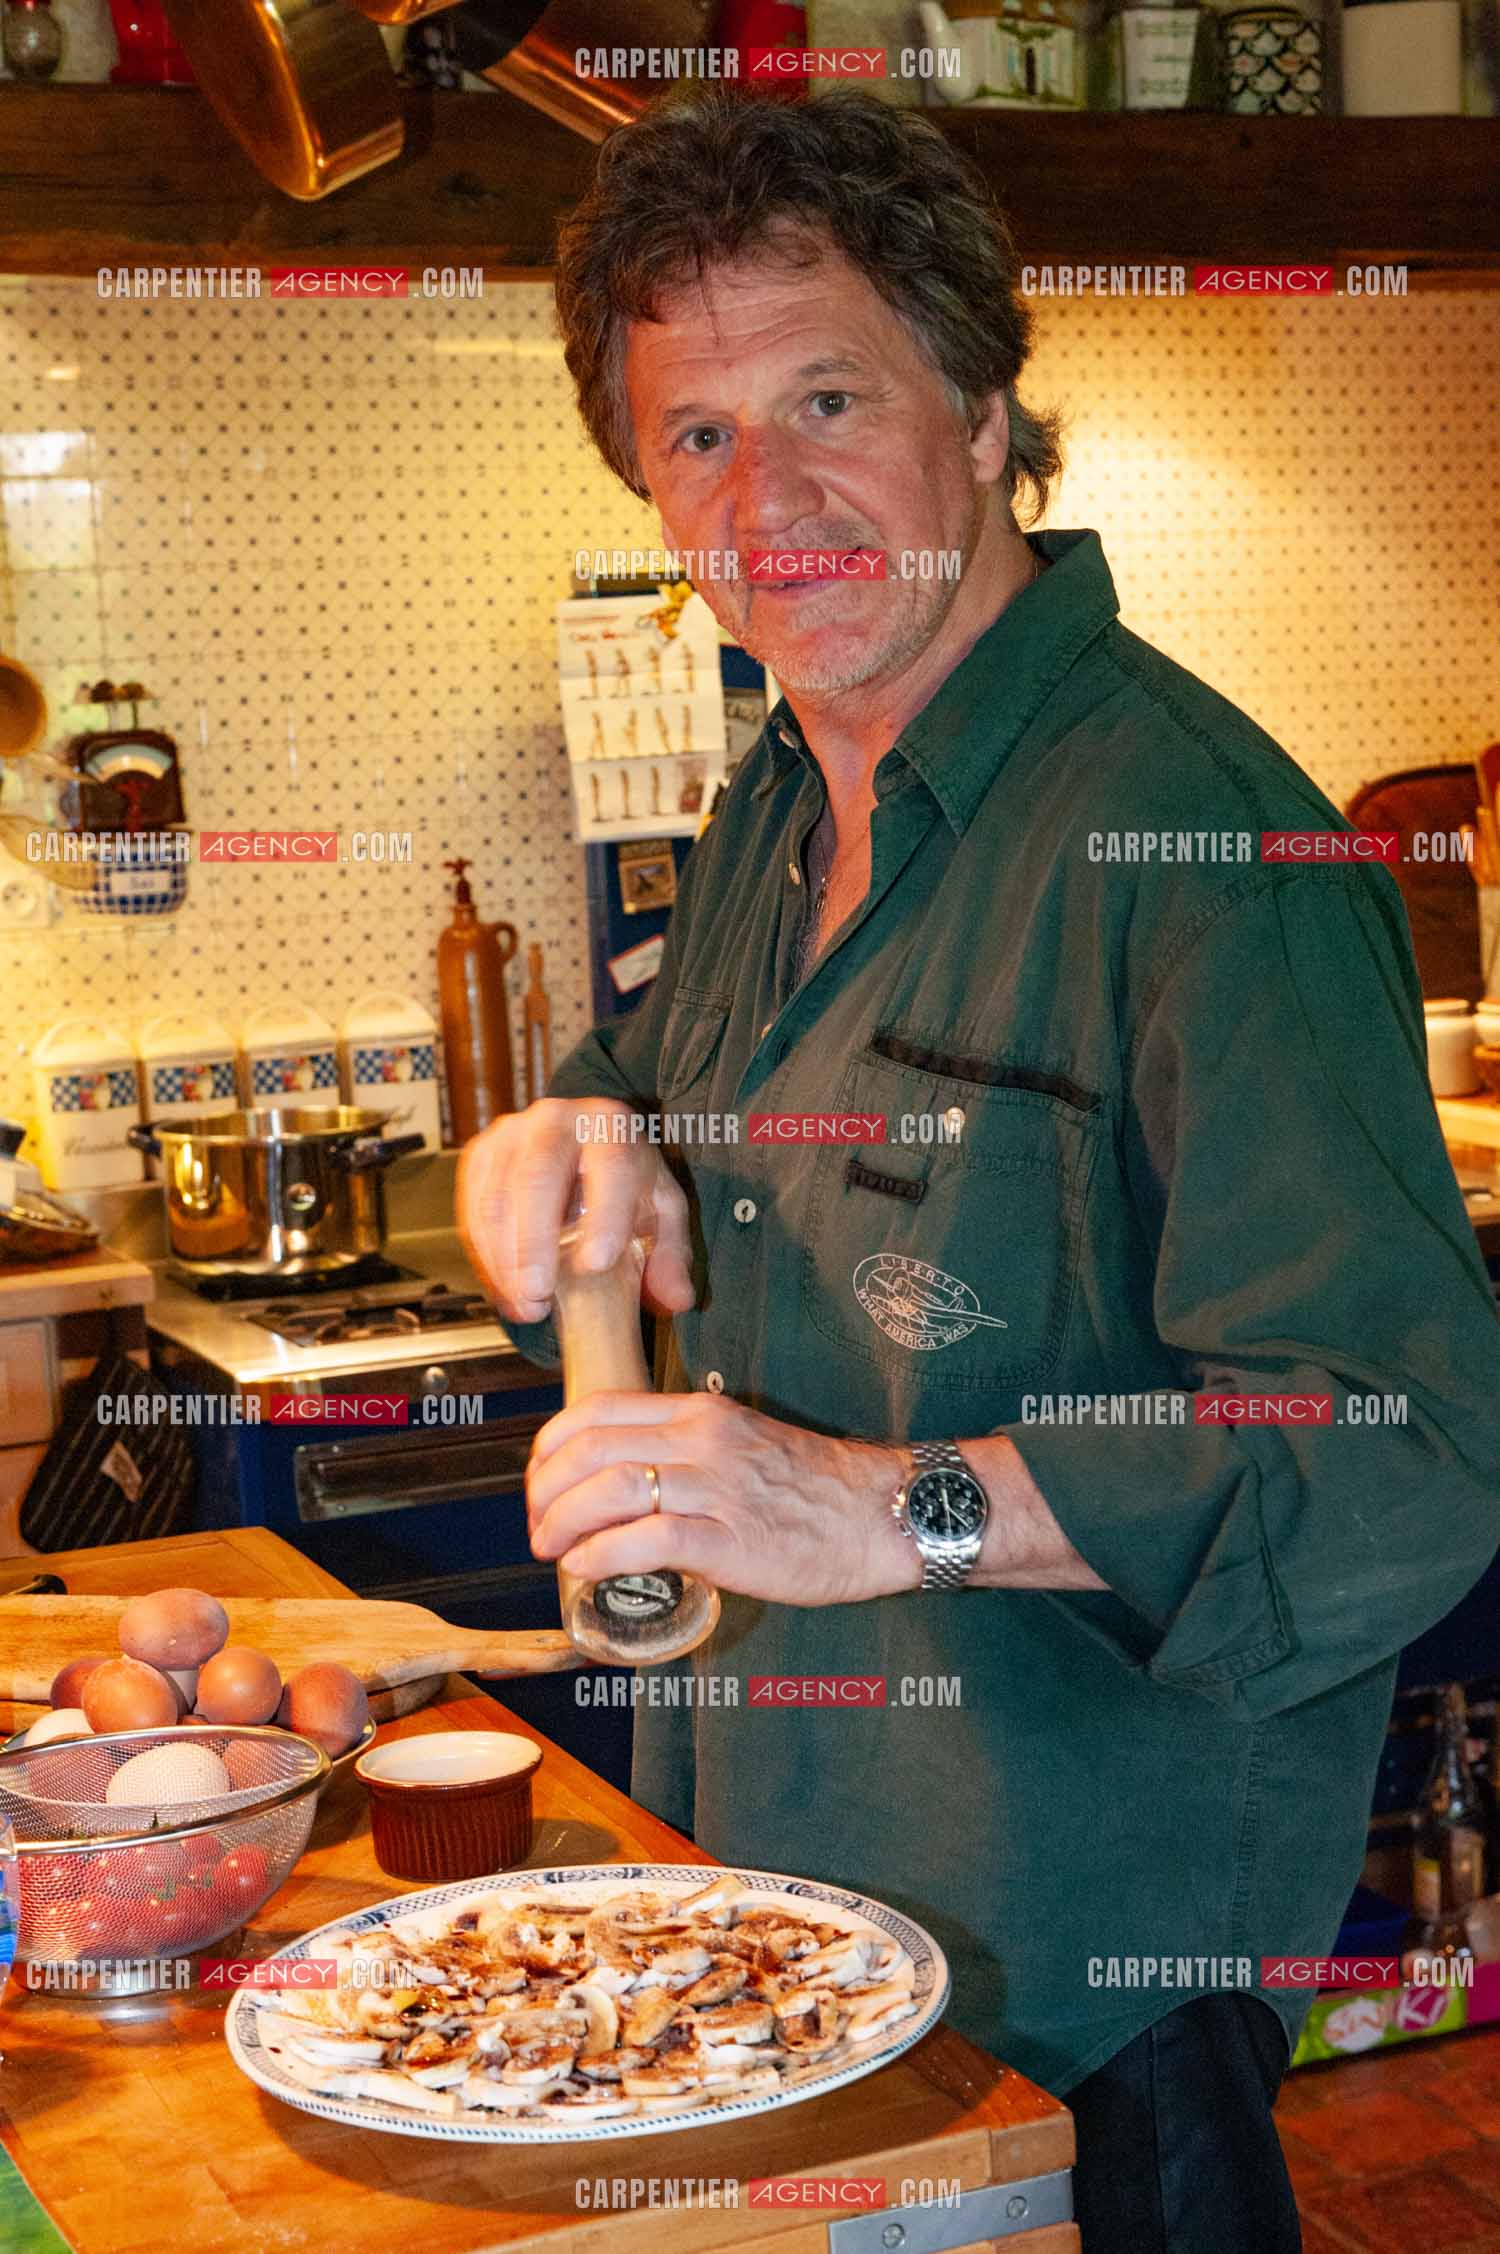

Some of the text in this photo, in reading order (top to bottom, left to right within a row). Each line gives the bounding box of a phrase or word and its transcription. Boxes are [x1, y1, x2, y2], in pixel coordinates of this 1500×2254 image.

[857, 1288, 969, 1348] WHAT AMERICA WAS
